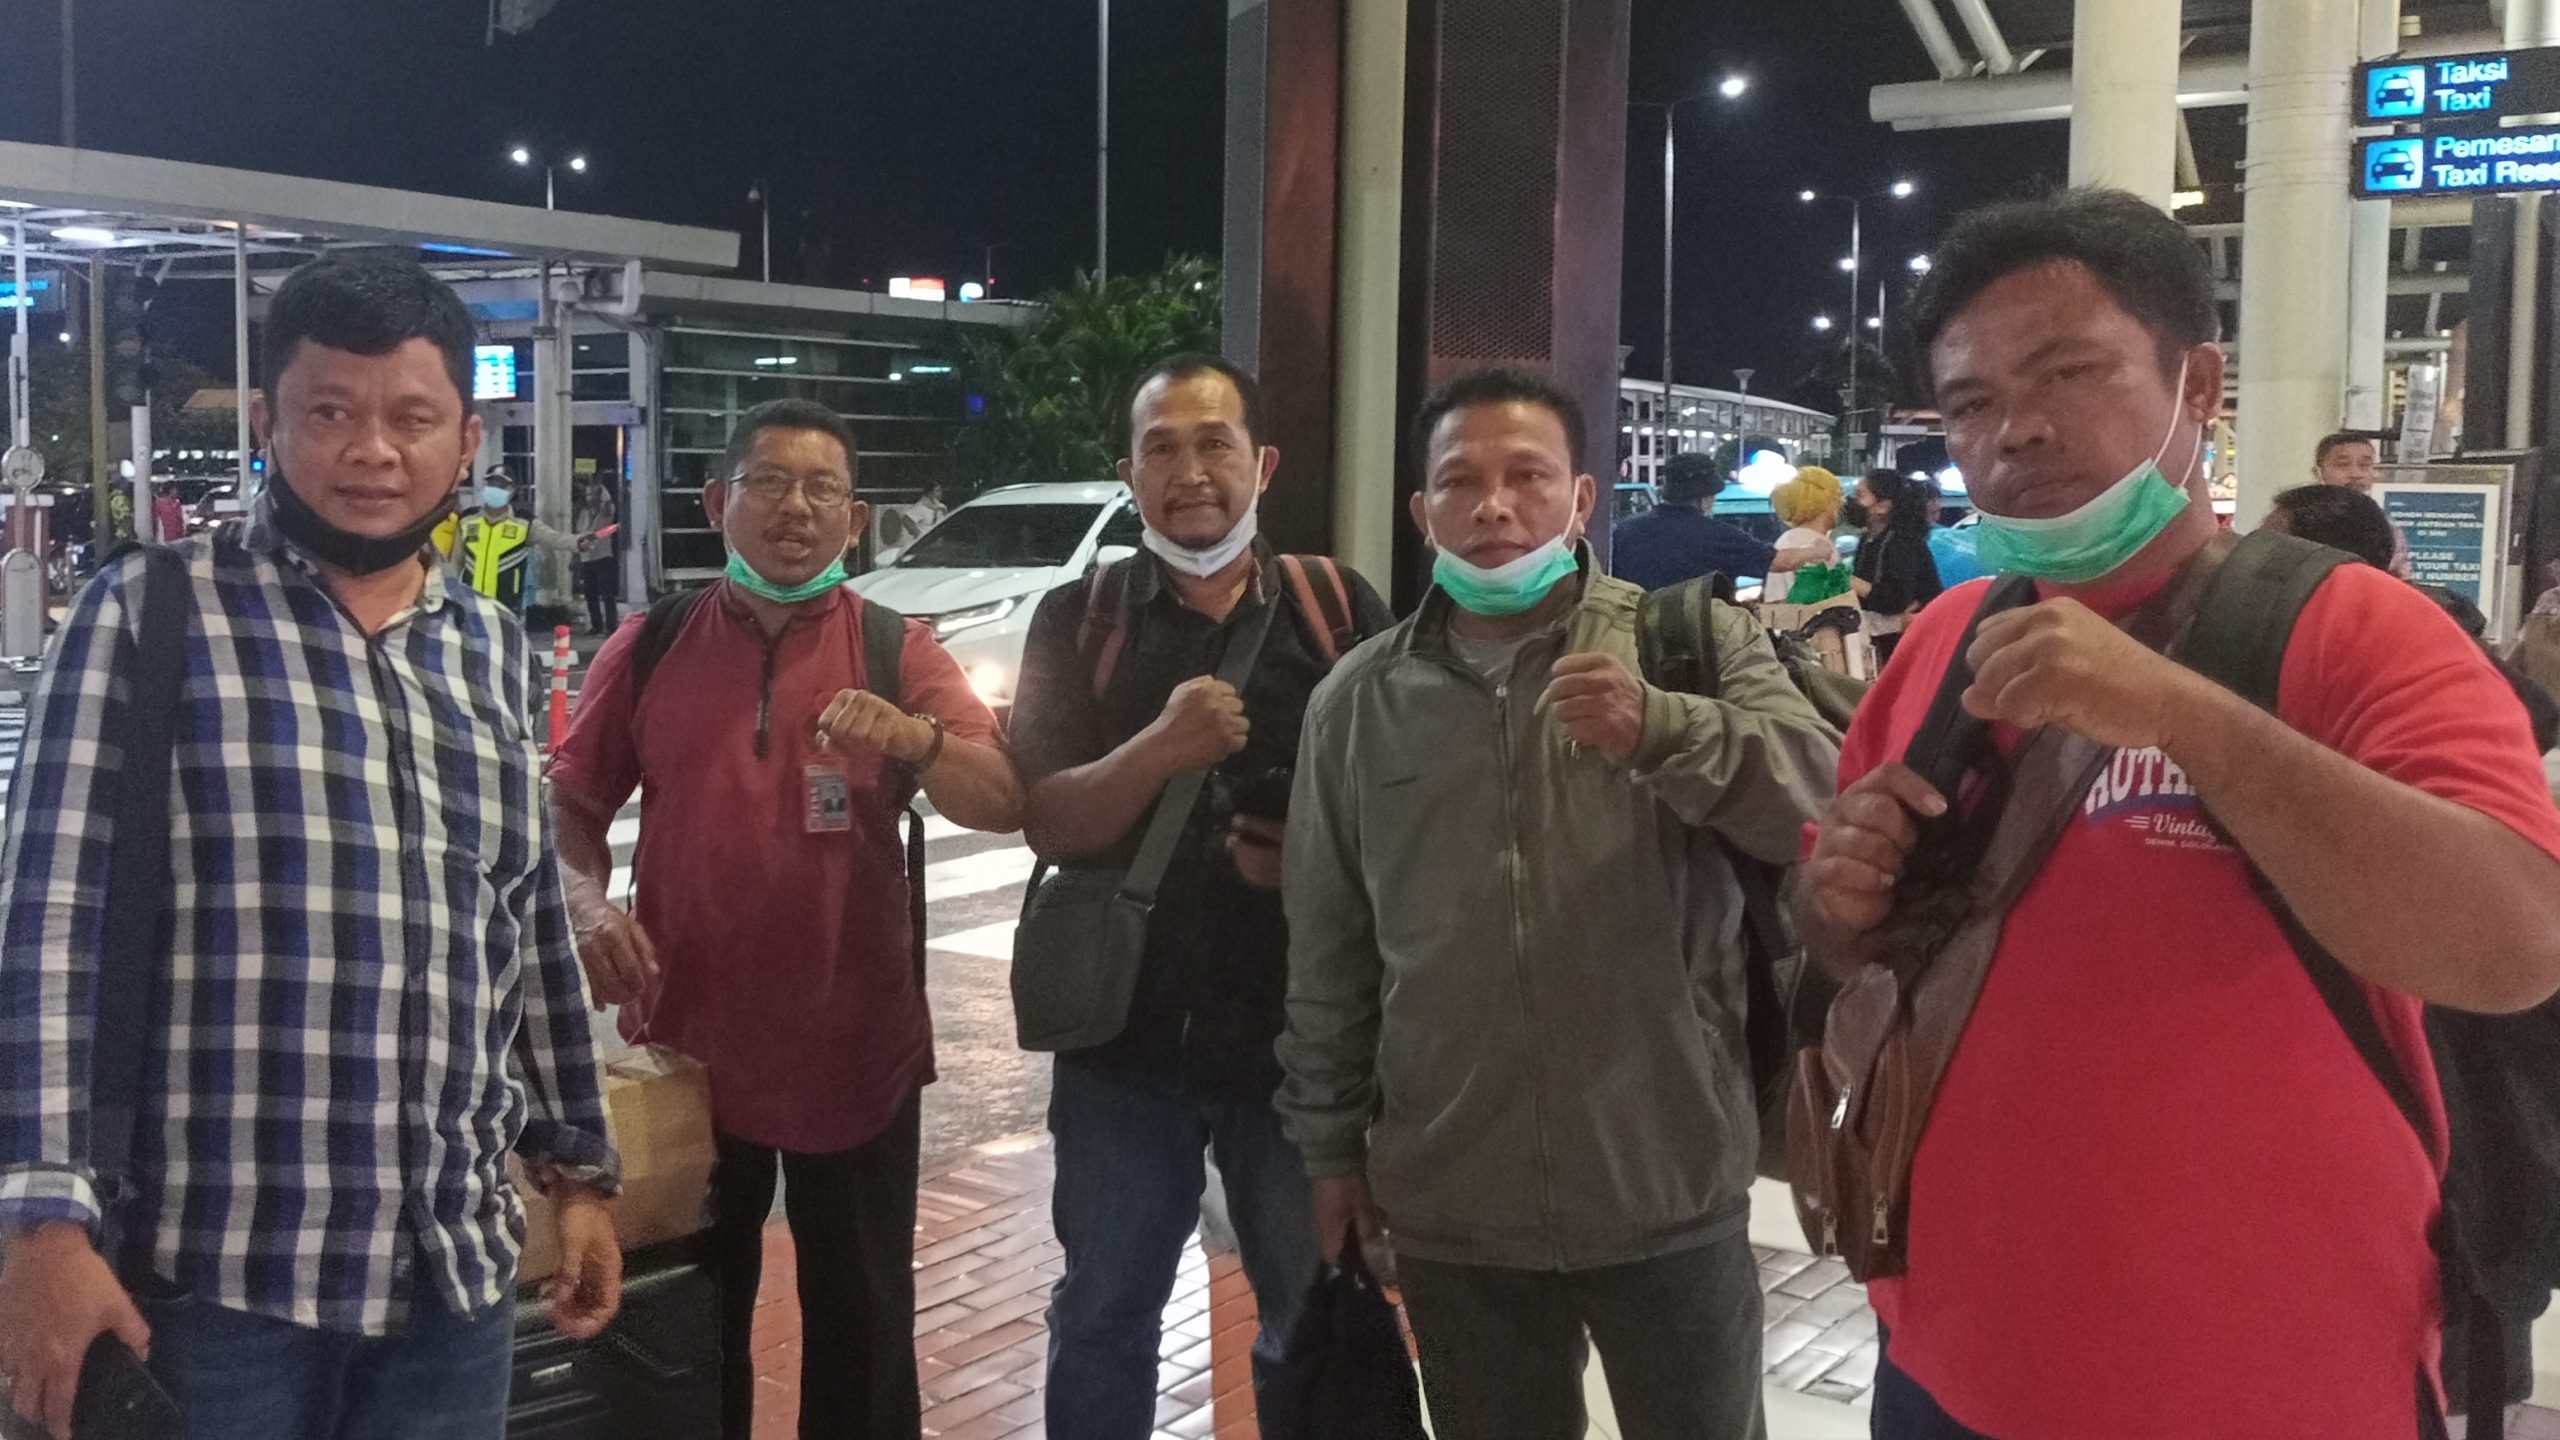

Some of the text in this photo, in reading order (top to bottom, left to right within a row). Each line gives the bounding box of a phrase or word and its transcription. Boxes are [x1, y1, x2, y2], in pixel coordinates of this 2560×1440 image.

[2434, 57, 2508, 84] Taksi
[2433, 86, 2491, 112] Taxi
[2435, 133, 2560, 158] Pemesan
[2431, 162, 2488, 187] Taxi
[2408, 551, 2454, 560] PLEASE
[2417, 561, 2481, 571] YOUR TAXI
[2425, 572, 2480, 582] NUMBER
[2085, 745, 2198, 816] AUTH
